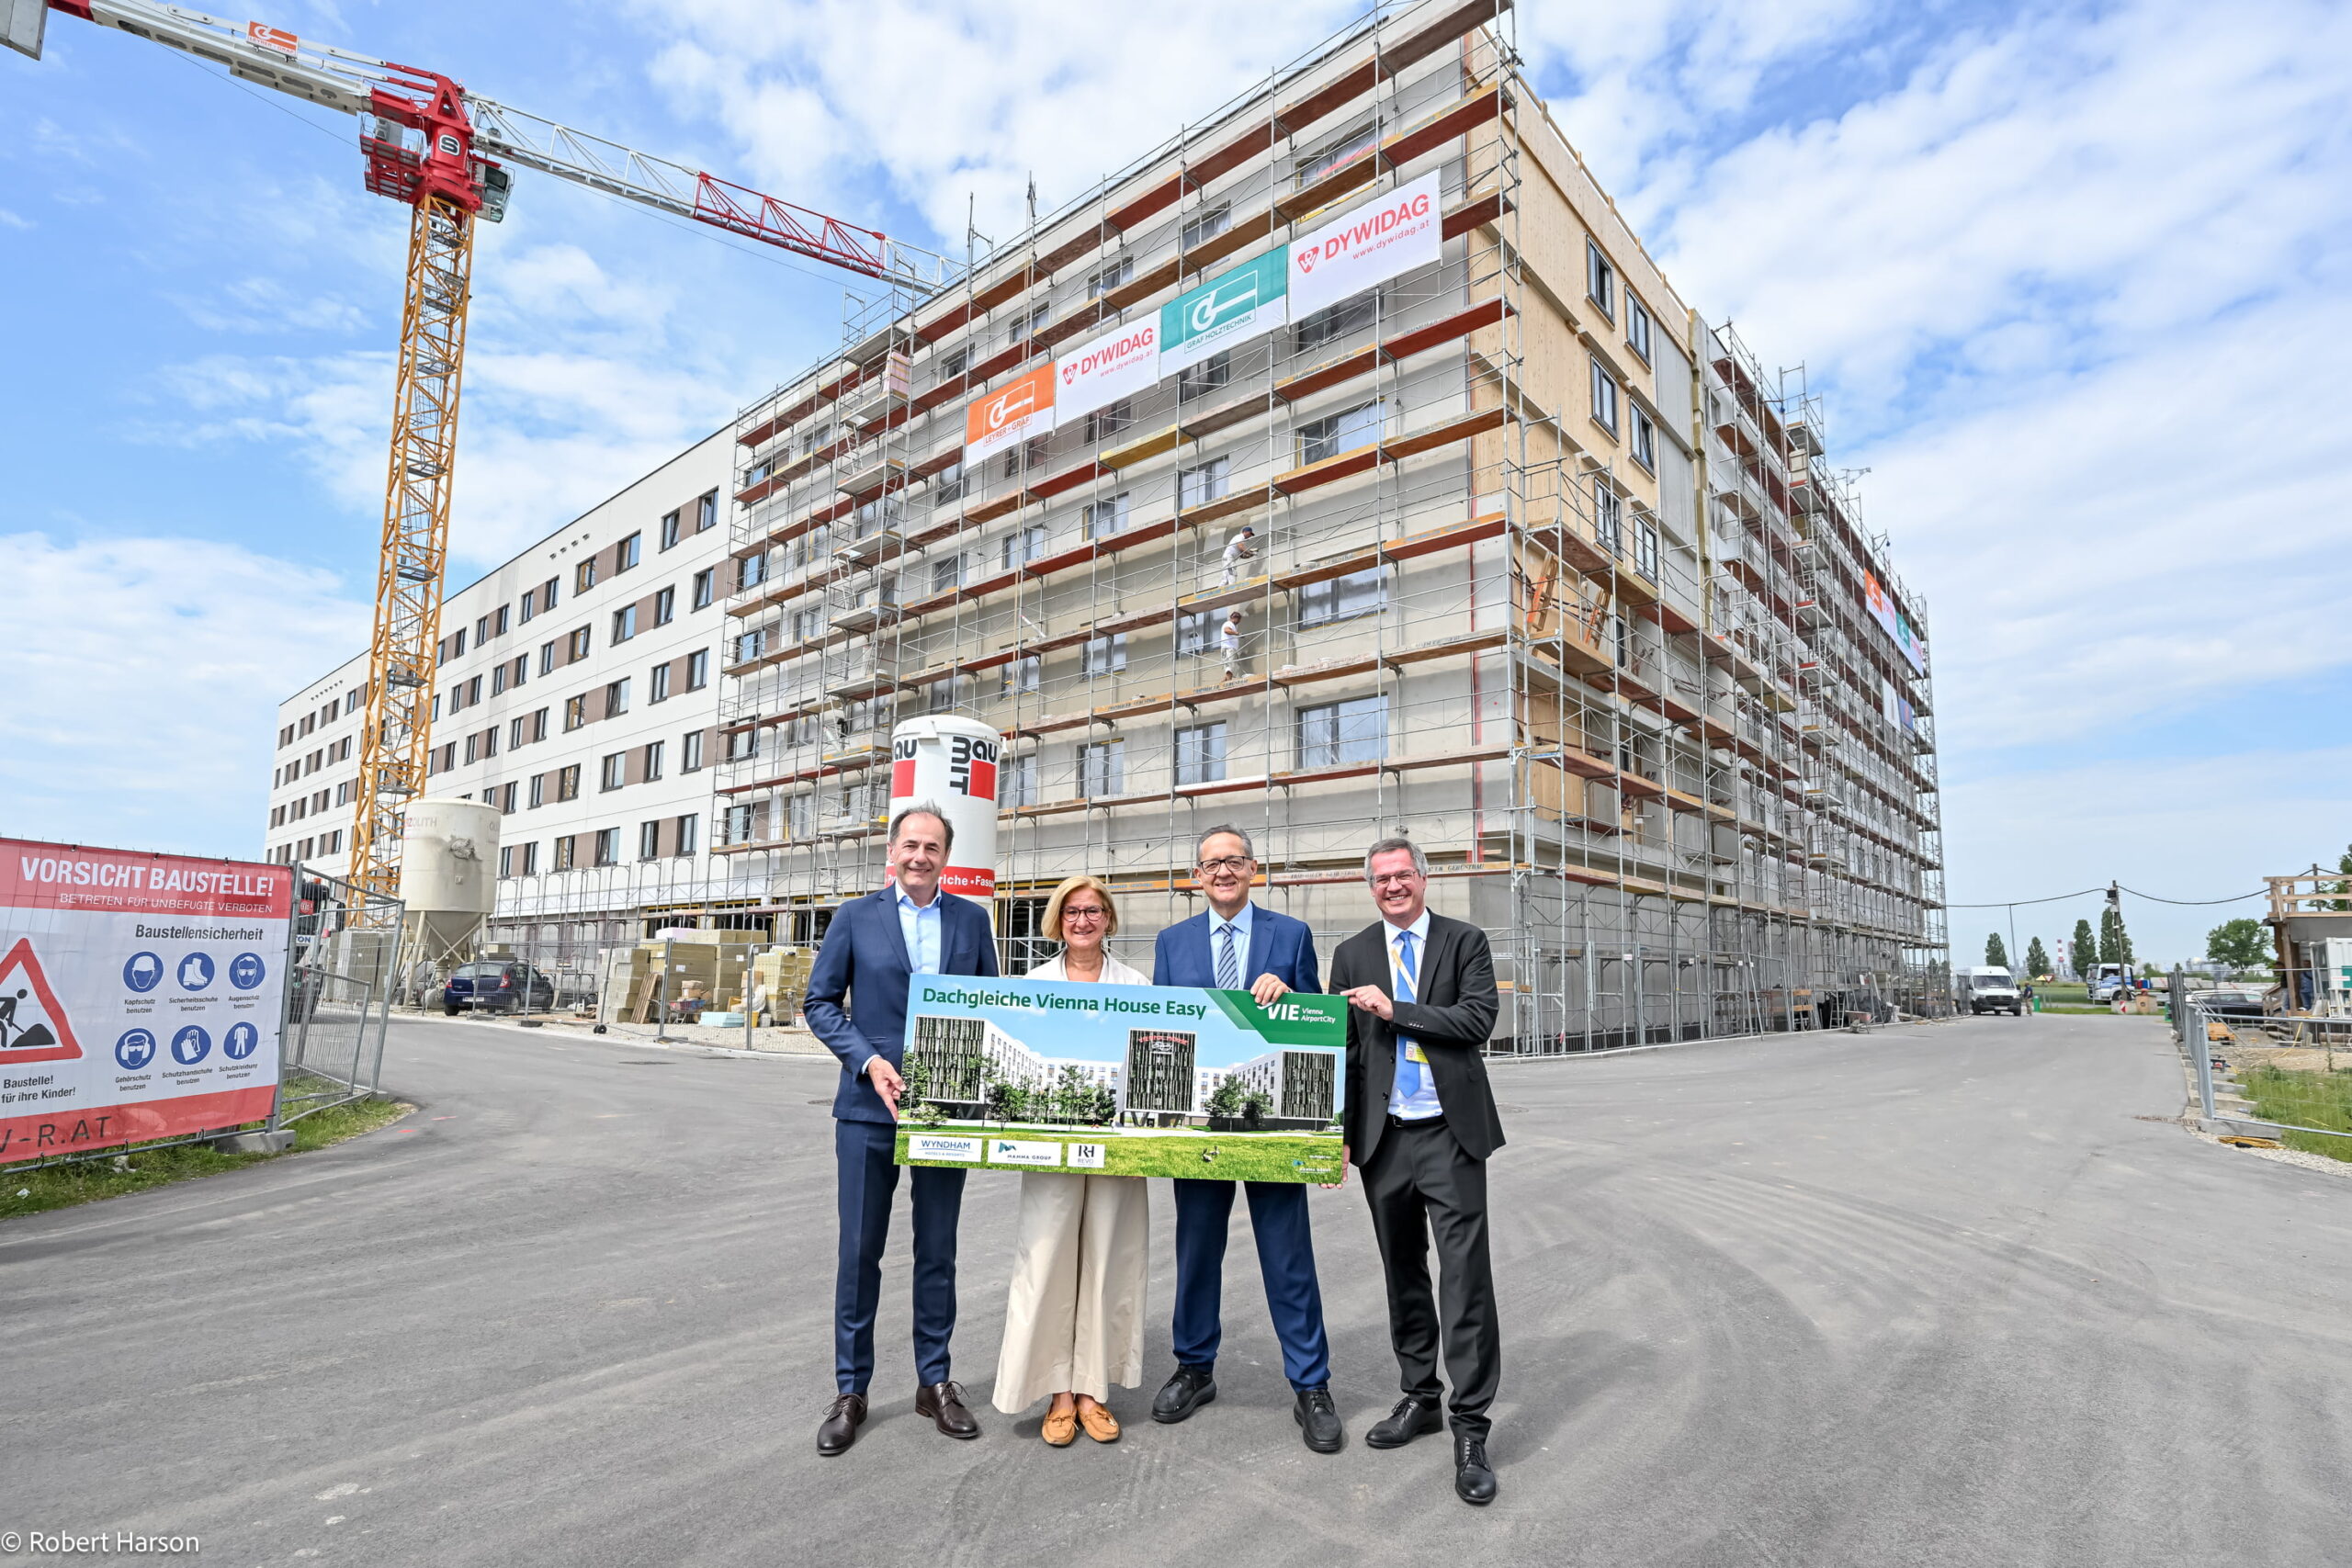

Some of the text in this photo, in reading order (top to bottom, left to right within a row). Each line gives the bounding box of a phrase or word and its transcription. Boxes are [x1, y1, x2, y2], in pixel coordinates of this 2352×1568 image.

[1324, 194, 1430, 260] DYWIDAG
[1352, 220, 1430, 260] www.dywidag.at
[1186, 314, 1251, 349] GRAF HOLZTECHNIK
[1080, 327, 1153, 376] DYWIDAG
[1100, 350, 1153, 378] www.dywidag.at
[985, 426, 1008, 444] LEYRER
[1012, 416, 1030, 431] GRAF
[21, 856, 274, 897] VORSICHT BAUSTELLE!
[938, 874, 968, 886] riche
[60, 893, 273, 913] BETRETEN FÜR UNBEFUGTE VERBOTEN
[135, 924, 264, 941] Baustellensicherheit
[295, 935, 311, 944] ON
[169, 996, 219, 1004] Sicherheitsschuhe
[922, 987, 1206, 1021] Dachgleiche Vienna House Easy
[1268, 1003, 1300, 1021] VIE
[1301, 1014, 1336, 1024] AirportCity
[115, 1074, 152, 1083] Gehörschutz
[162, 1068, 213, 1078] Schutzhandschuhe
[176, 1077, 200, 1086] benutzen
[226, 1072, 251, 1080] benutzen
[3, 1075, 54, 1089] Baustelle!
[119, 1083, 146, 1091] benutzen
[1, 1087, 76, 1104] für ihre Kinder!
[921, 1139, 971, 1150] WYNDHAM
